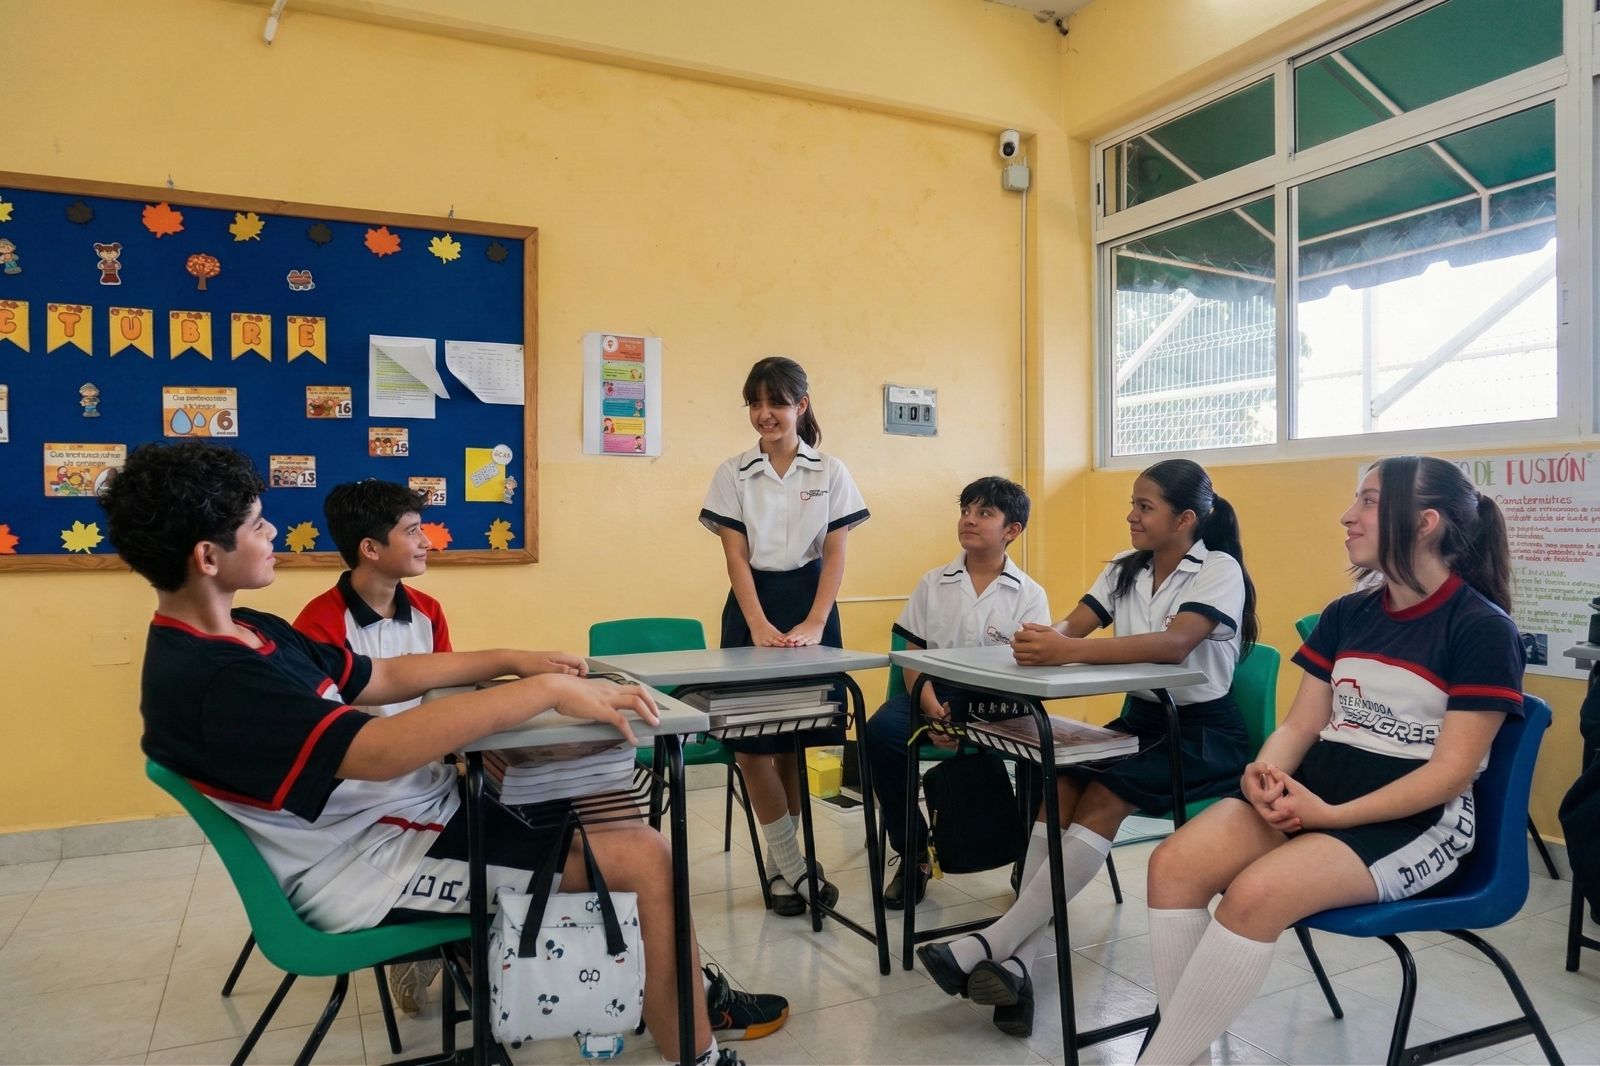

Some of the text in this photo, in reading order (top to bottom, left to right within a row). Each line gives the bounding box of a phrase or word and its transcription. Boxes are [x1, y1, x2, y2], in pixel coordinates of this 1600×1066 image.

[337, 403, 351, 414] 16
[217, 410, 234, 430] 6
[1474, 460, 1497, 486] DE
[1506, 452, 1586, 486] FUSIÓN
[433, 493, 445, 502] 25
